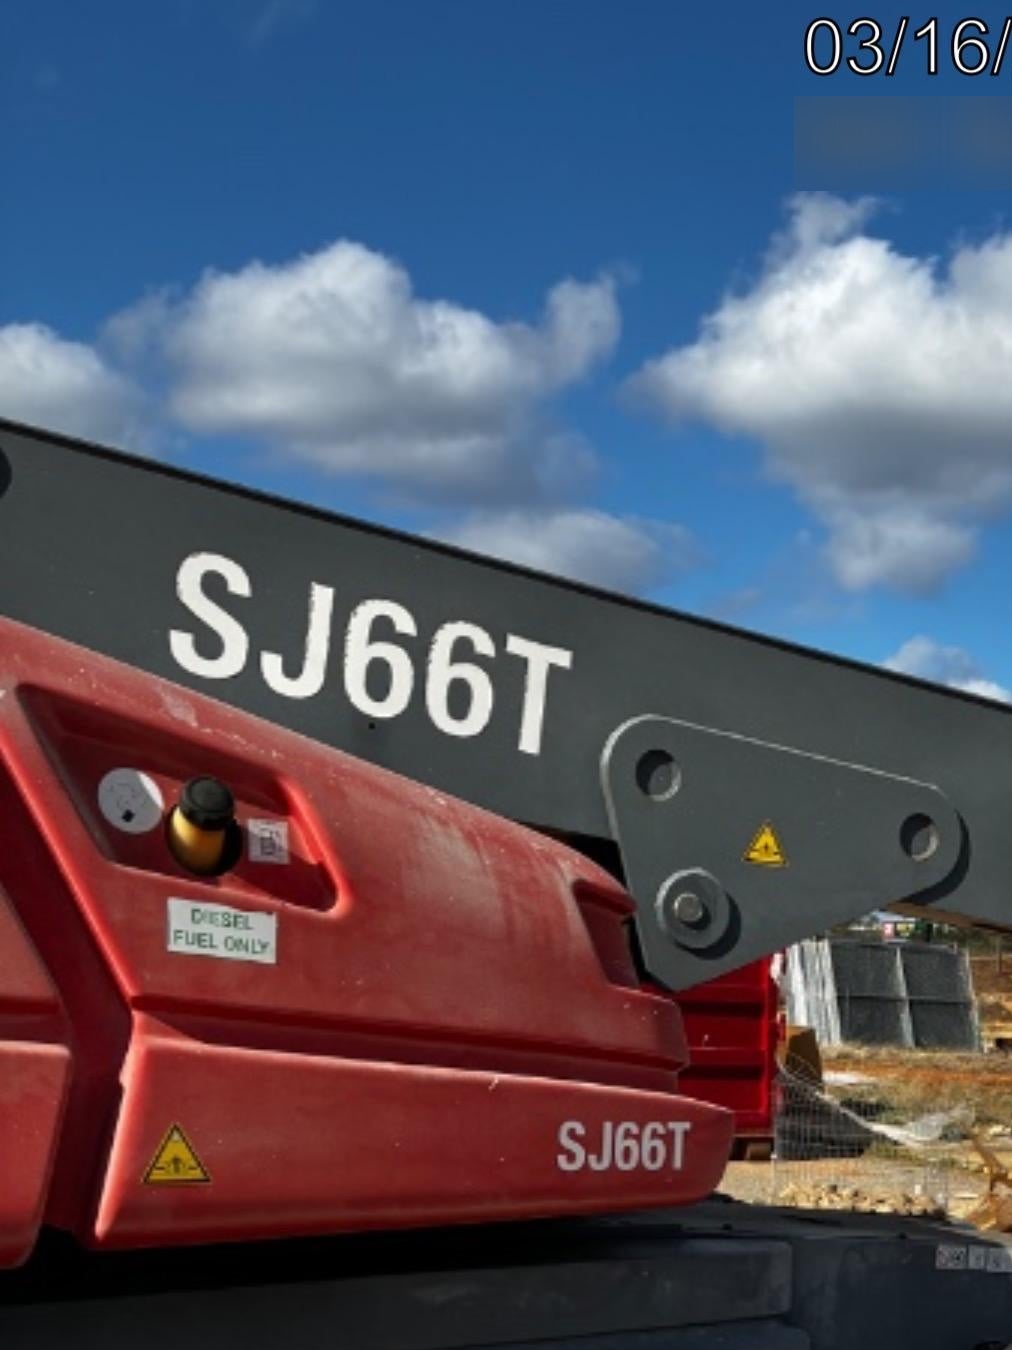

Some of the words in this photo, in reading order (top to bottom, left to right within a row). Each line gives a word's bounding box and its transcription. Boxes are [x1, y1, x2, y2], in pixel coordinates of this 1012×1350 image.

[169, 551, 574, 755] SJ66T
[191, 908, 253, 931] DIESEL
[173, 929, 218, 949] FUEL
[224, 936, 270, 955] ONLY
[556, 1120, 692, 1172] SJ66T
